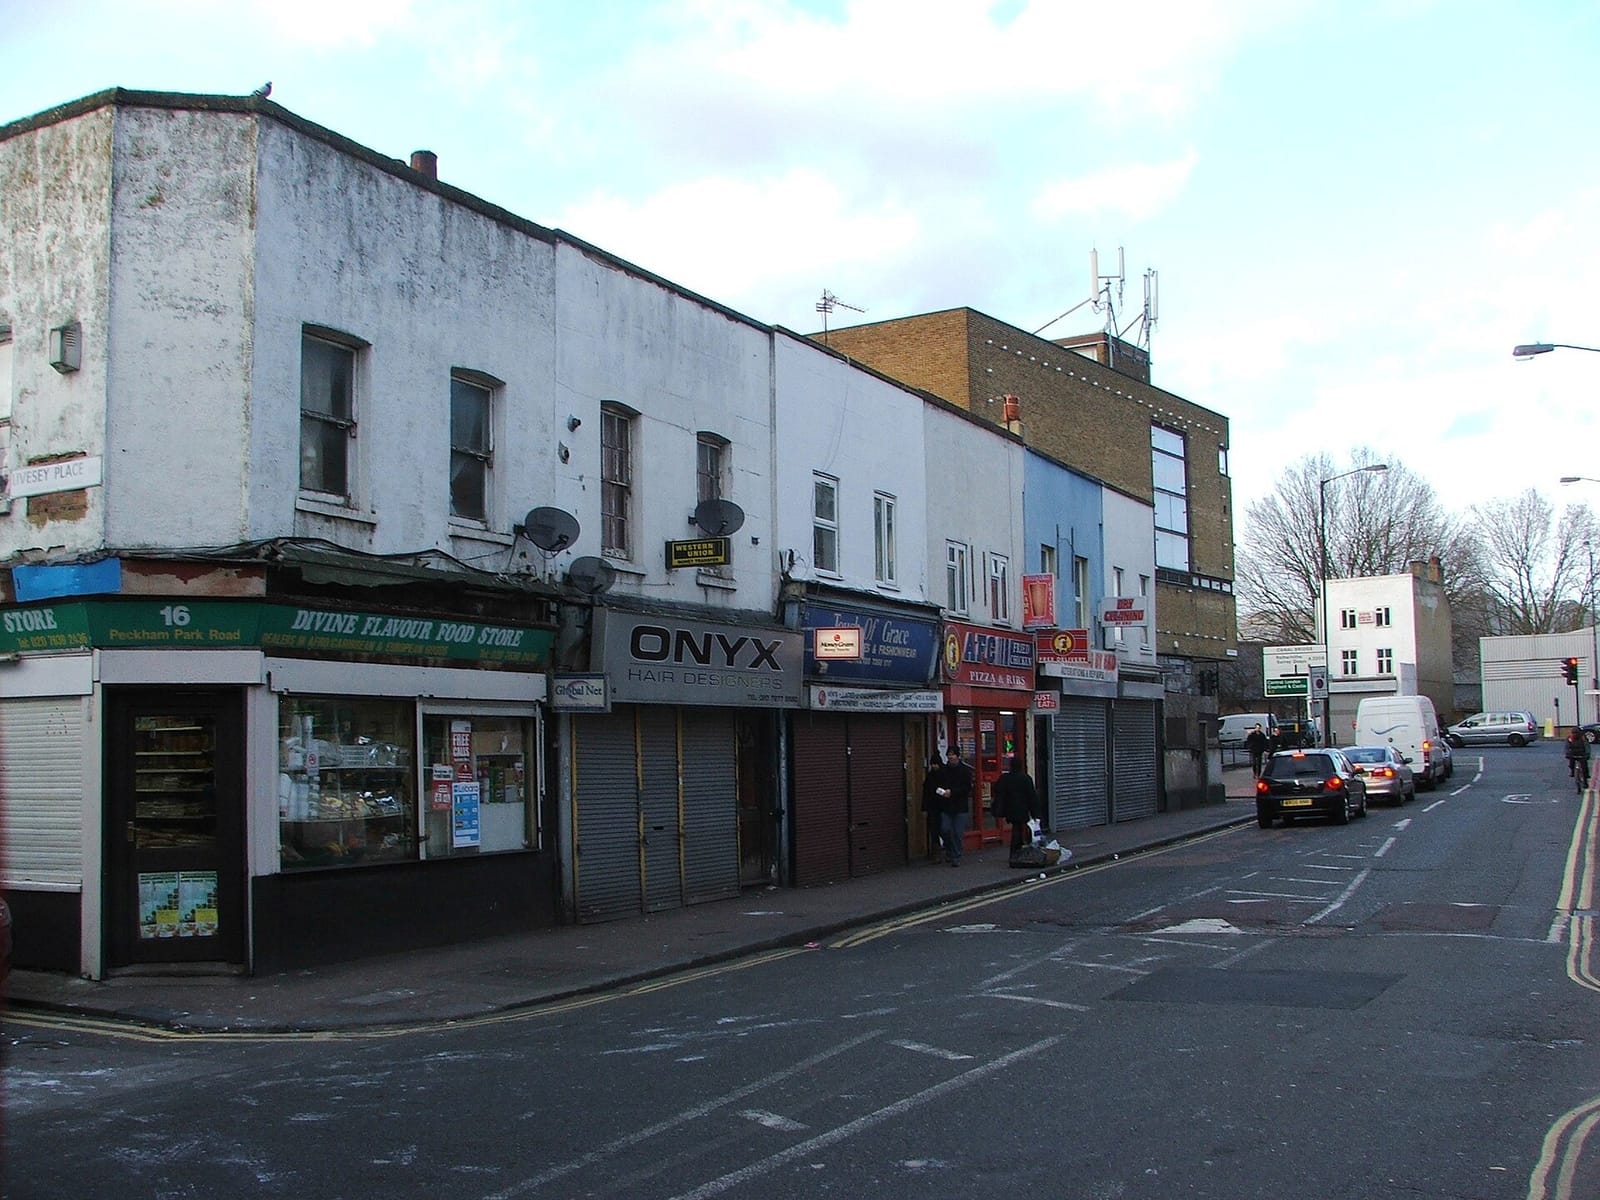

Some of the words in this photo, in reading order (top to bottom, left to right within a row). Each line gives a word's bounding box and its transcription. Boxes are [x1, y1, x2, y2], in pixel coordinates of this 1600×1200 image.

[13, 468, 49, 486] LIVESEY
[54, 462, 83, 480] PLACE
[675, 543, 714, 551] WESTERN
[687, 549, 714, 557] UNION
[3, 608, 57, 633] STORE
[160, 605, 191, 626] 16
[109, 629, 169, 640] Peckham
[174, 629, 203, 640] Park
[209, 629, 240, 641] Road
[291, 610, 359, 634] DIVINE
[361, 617, 433, 641] FLAVOUR
[436, 623, 475, 643] FOOD
[478, 627, 524, 647] STORE
[882, 620, 910, 645] Grace
[629, 624, 784, 672] ONYX
[1012, 642, 1030, 655] FRIED
[628, 669, 674, 683] HAIR
[683, 672, 783, 690] DESIGNERS
[969, 670, 996, 683] PIZZA
[998, 675, 1005, 684] &
[1006, 674, 1026, 686] RIBS
[556, 684, 584, 696] Global
[586, 685, 602, 696] Net
[1034, 693, 1051, 701] JUST
[1038, 700, 1051, 708] EAT
[453, 733, 470, 746] FREE
[453, 746, 470, 757] CALLS
